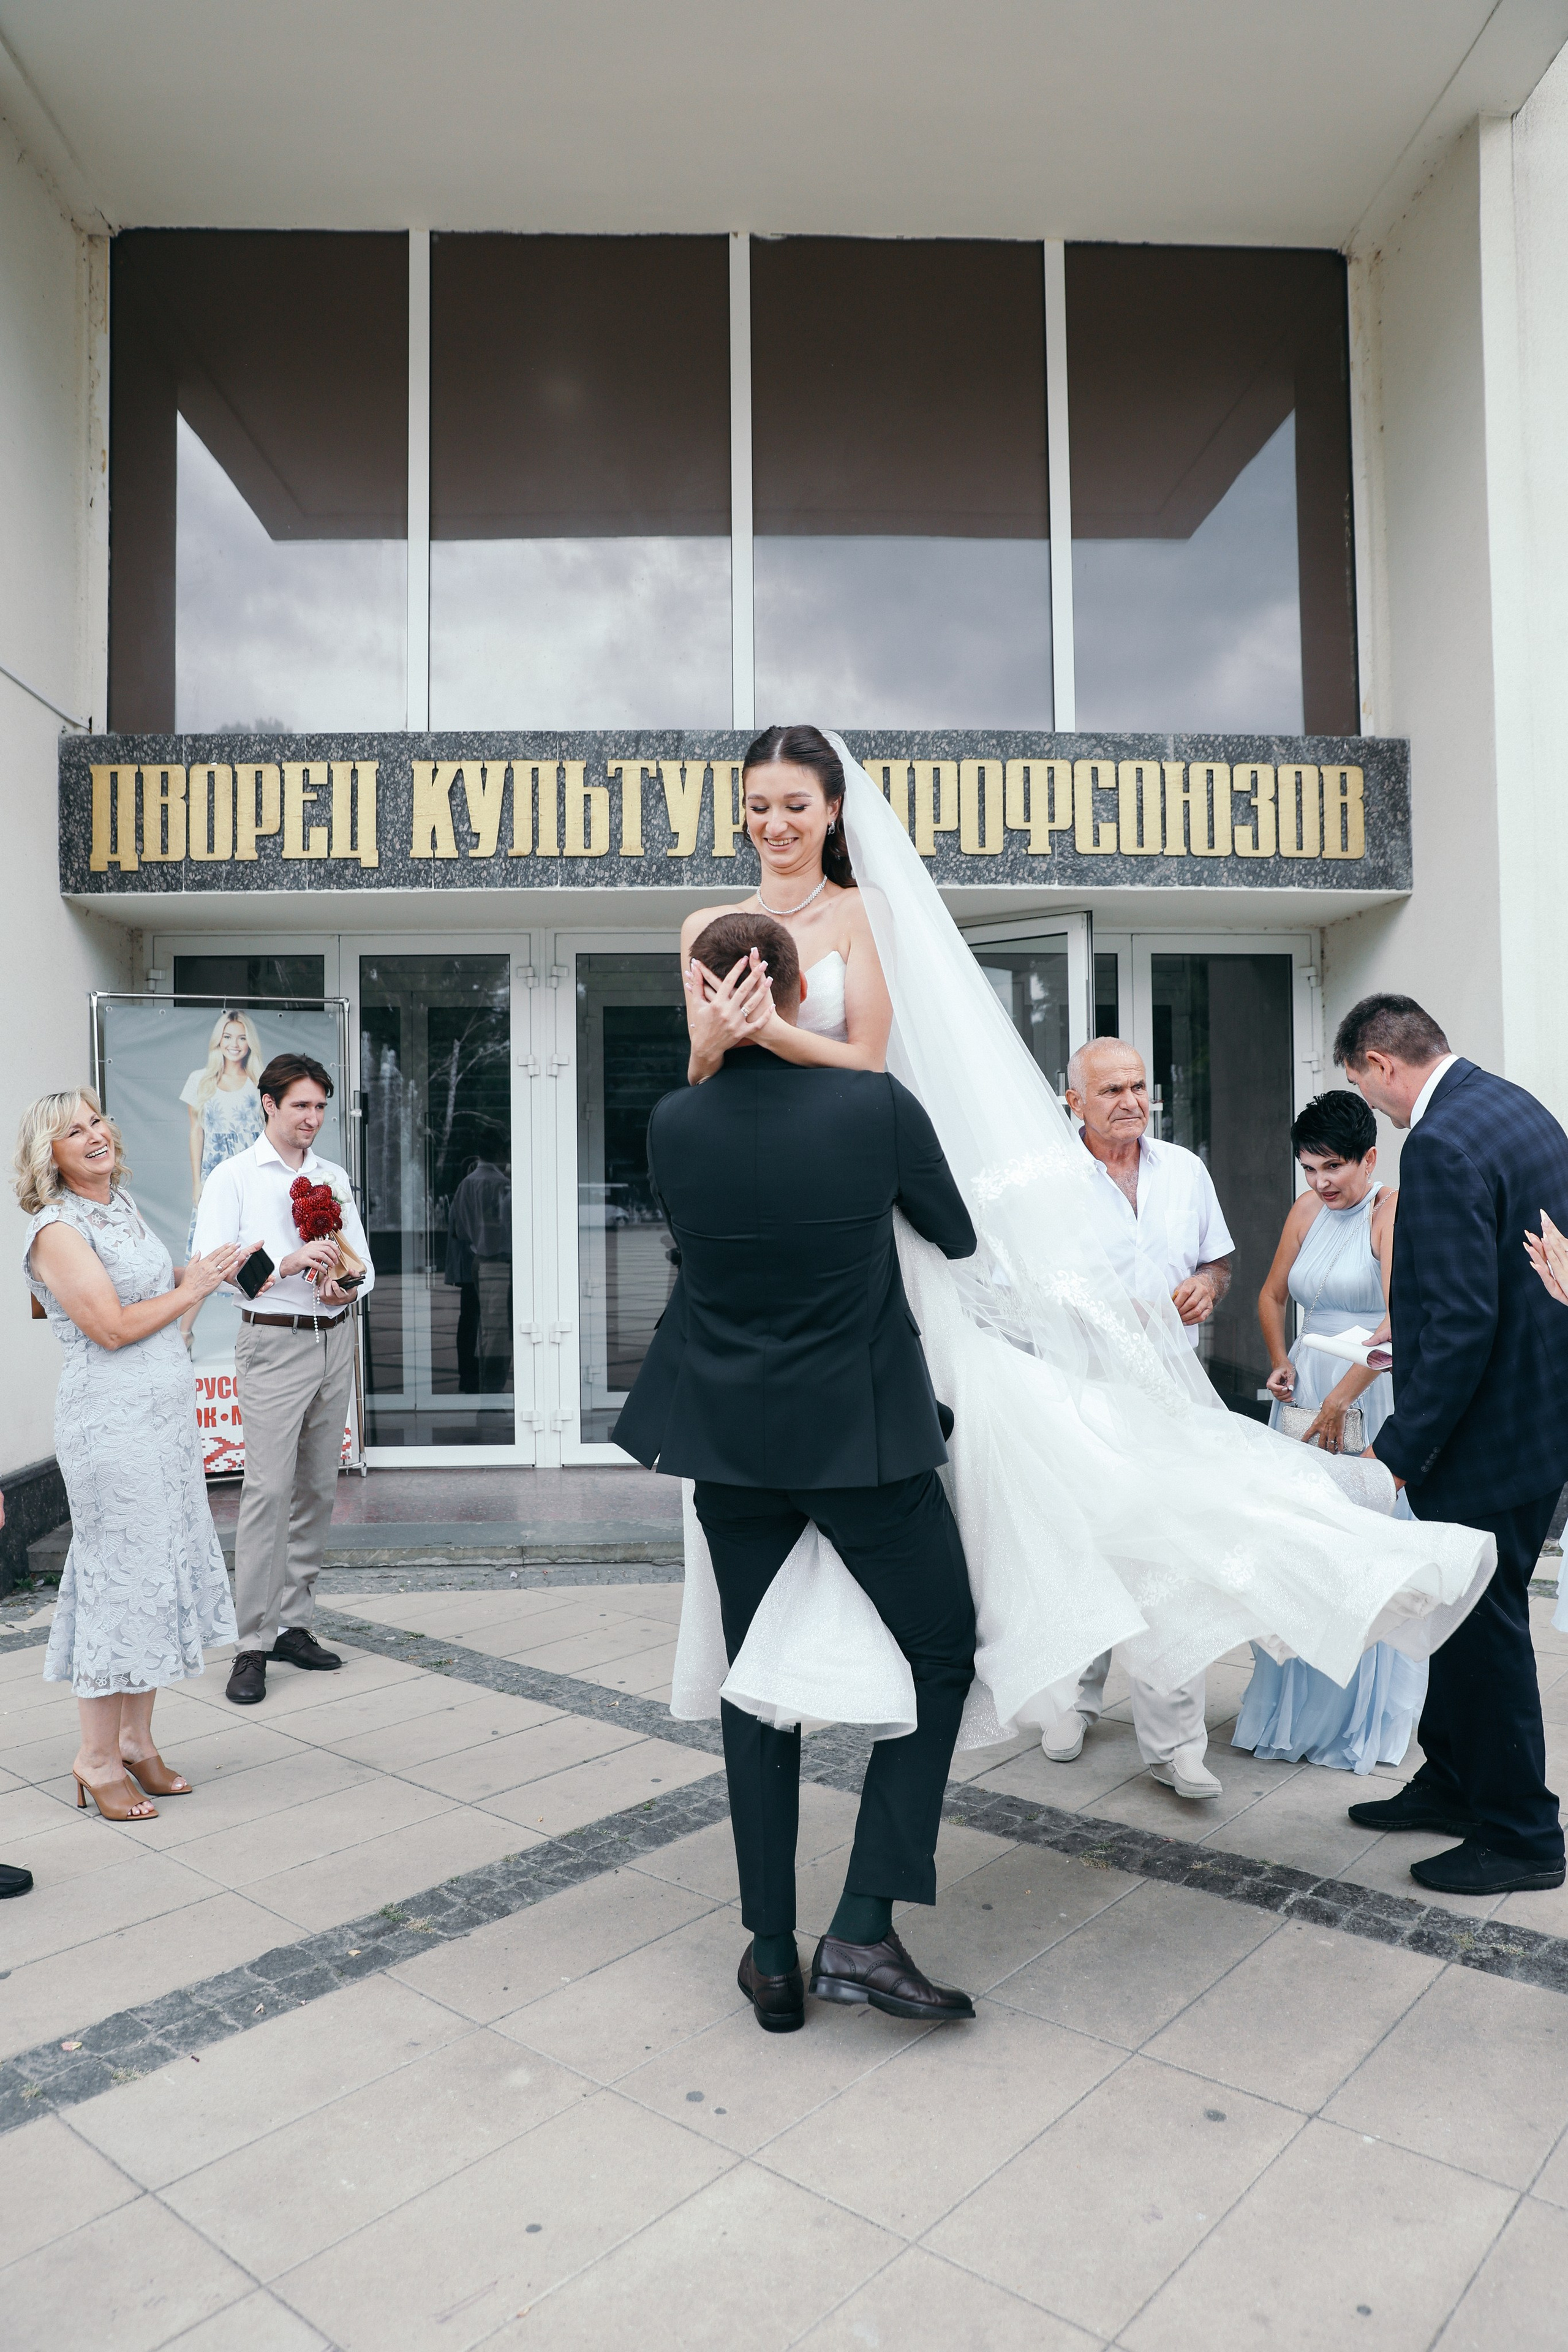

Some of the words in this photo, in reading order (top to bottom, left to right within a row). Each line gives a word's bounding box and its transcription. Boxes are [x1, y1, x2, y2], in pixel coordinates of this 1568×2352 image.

[90, 761, 379, 872] ДВОРЕЦ
[410, 760, 744, 859] КУЛЬТУР
[862, 758, 1365, 859] ПРОФСОЮЗОВ
